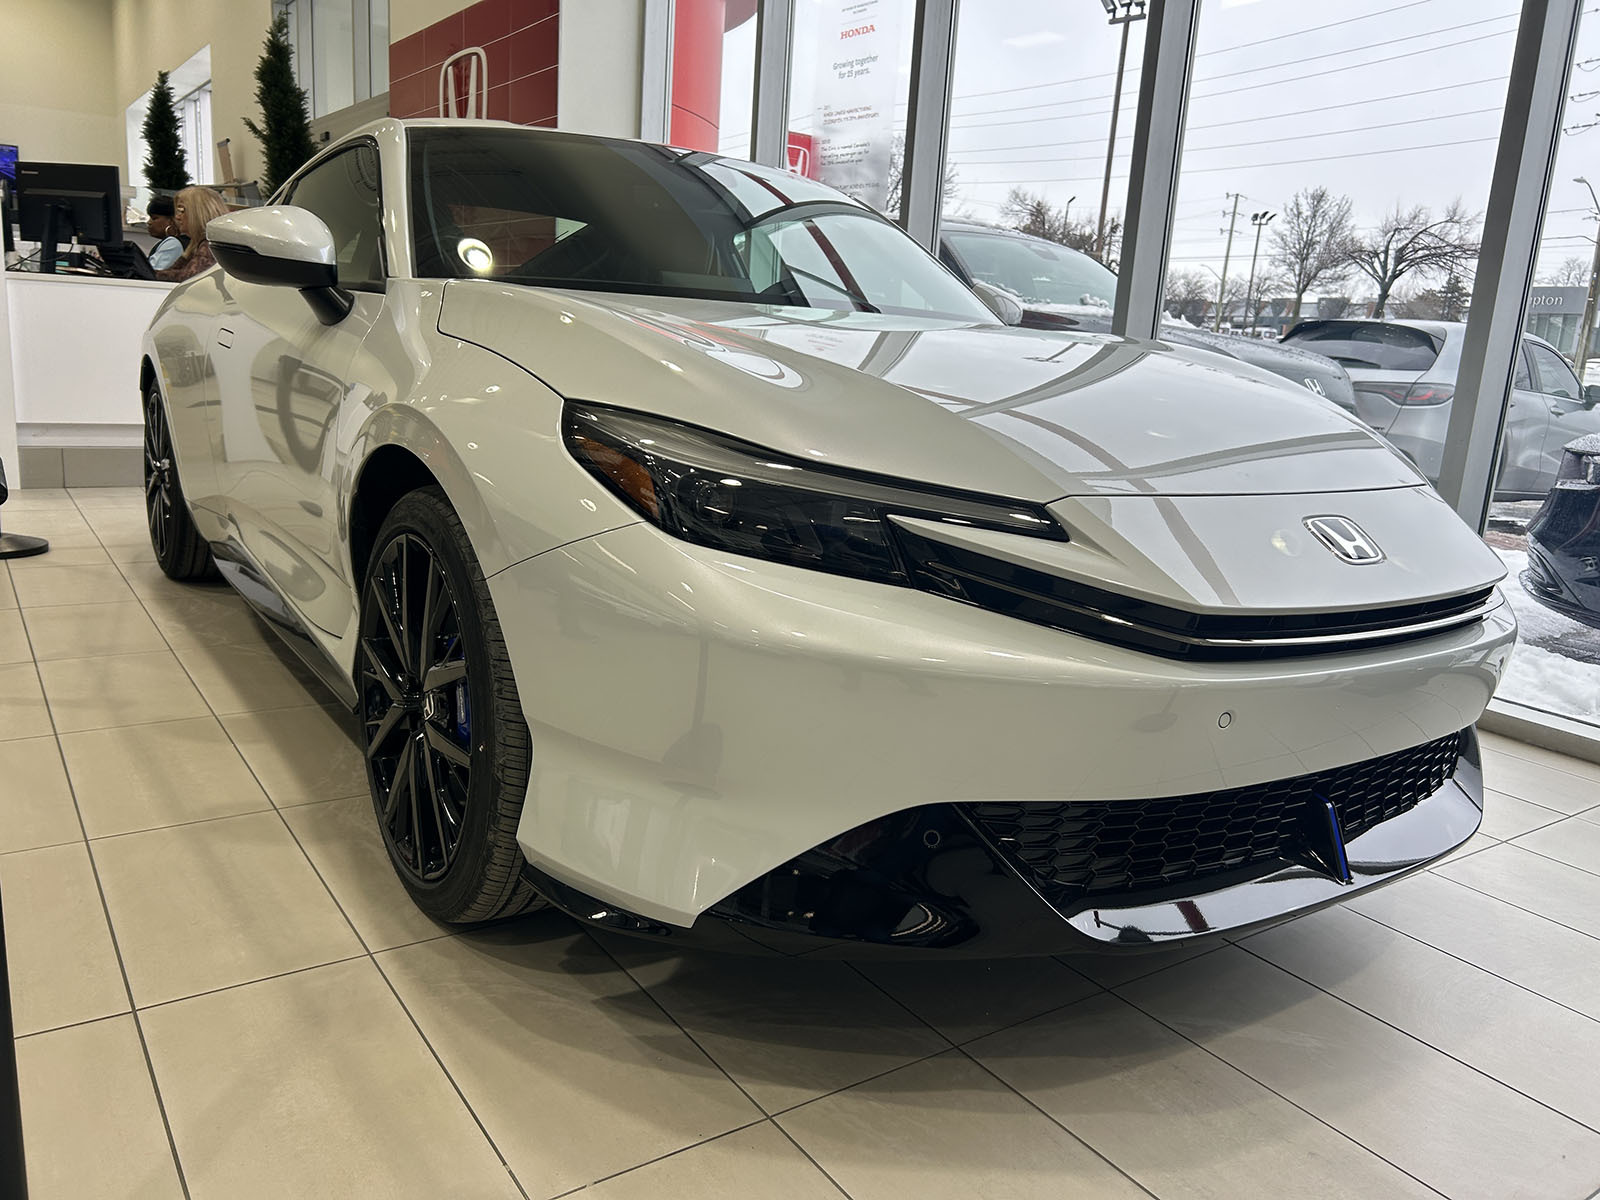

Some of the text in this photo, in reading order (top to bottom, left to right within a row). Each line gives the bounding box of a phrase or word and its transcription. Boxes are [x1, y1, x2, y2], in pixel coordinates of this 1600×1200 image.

[840, 24, 876, 40] HONDA
[832, 54, 879, 70] Growing together
[838, 70, 847, 79] for
